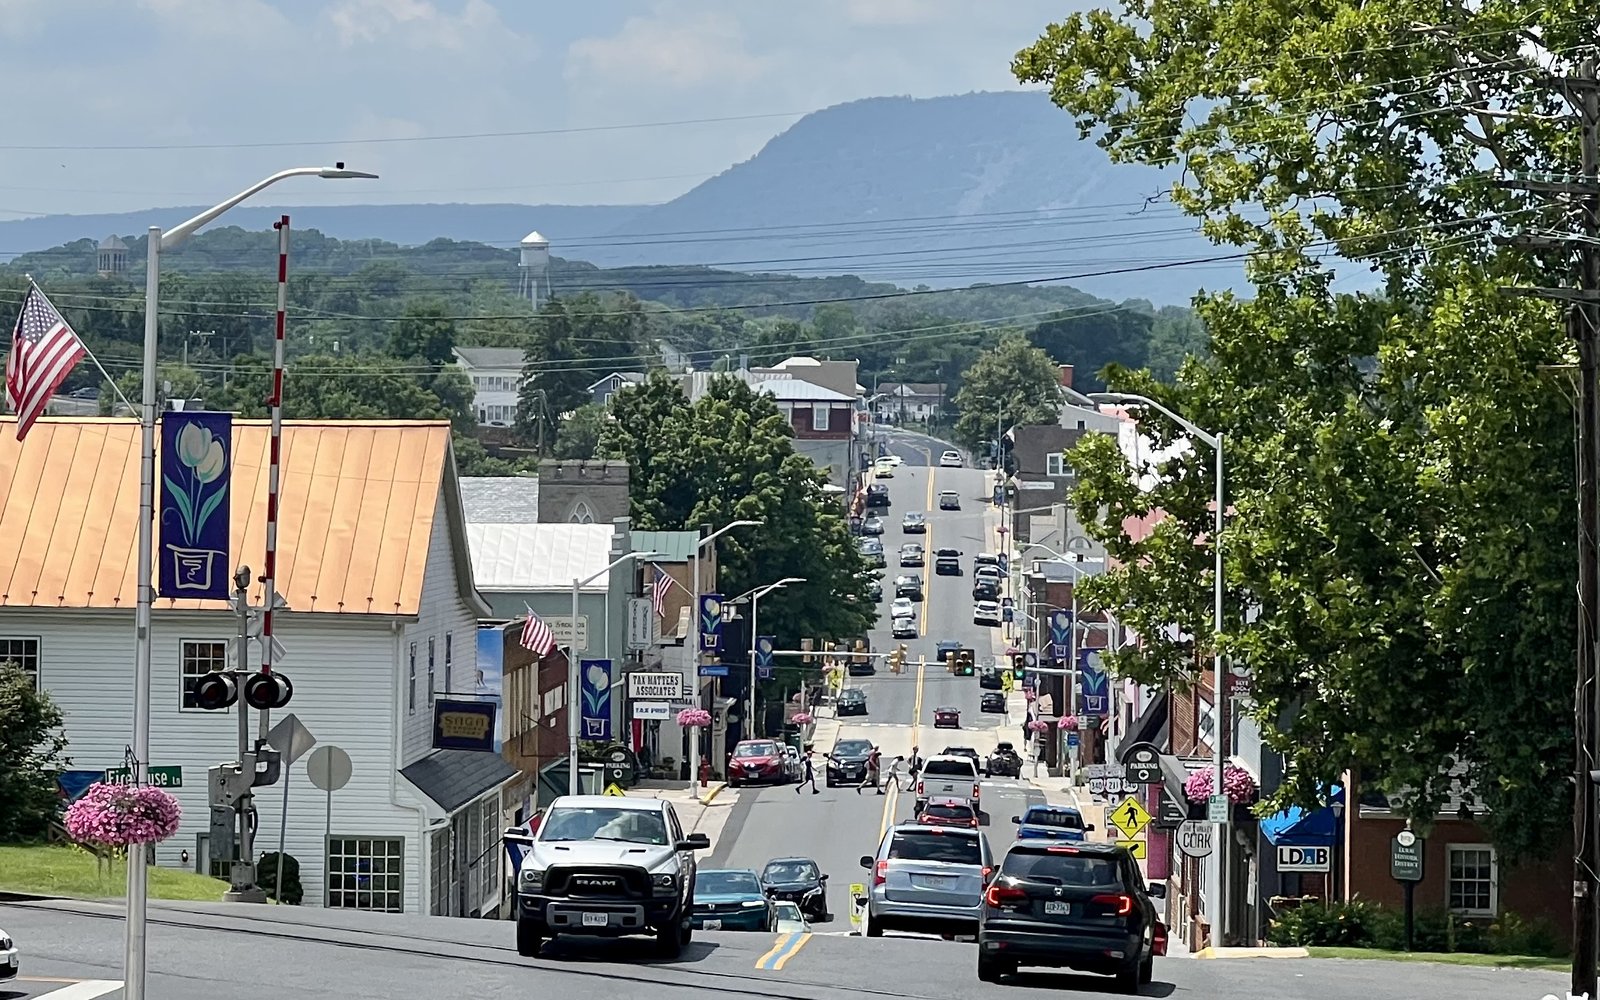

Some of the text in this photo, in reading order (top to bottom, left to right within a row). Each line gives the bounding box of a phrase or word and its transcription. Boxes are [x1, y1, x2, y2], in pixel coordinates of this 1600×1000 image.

[633, 675, 679, 686] TAX MATTERS
[636, 686, 676, 696] ASSOCIATES
[1130, 762, 1158, 770] PARKING
[108, 769, 168, 786] Fireuse
[1183, 833, 1212, 848] CORK
[1279, 847, 1328, 865] LD&B
